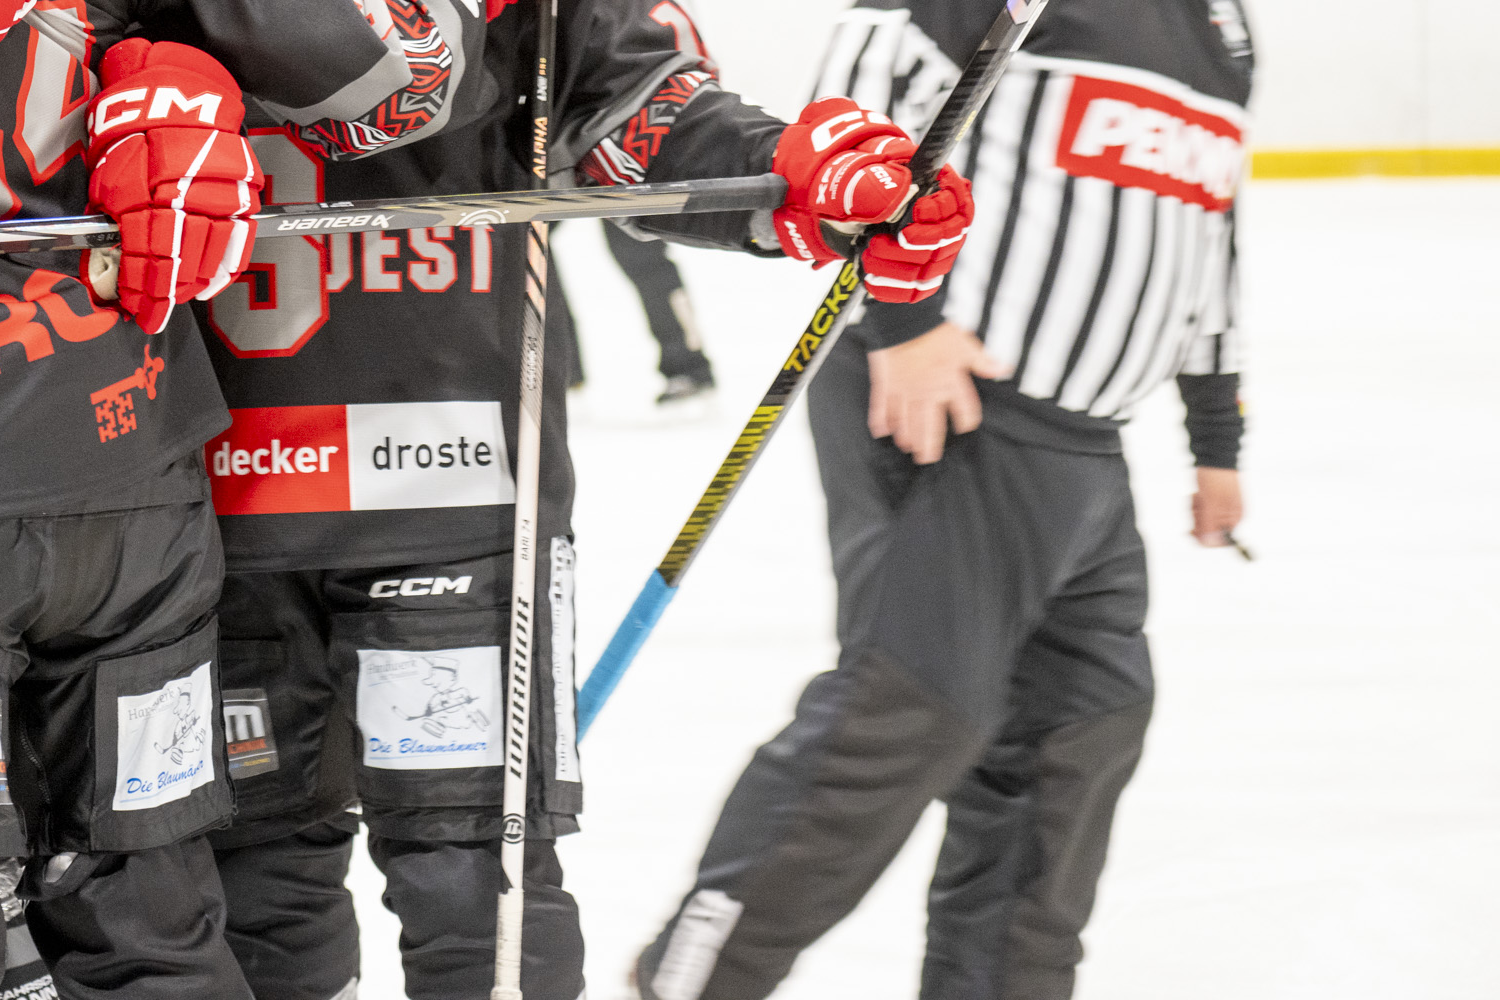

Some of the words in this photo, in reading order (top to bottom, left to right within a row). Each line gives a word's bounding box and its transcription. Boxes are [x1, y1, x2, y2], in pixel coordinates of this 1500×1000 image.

[88, 86, 223, 135] CM
[532, 116, 548, 179] ALPHA
[869, 165, 898, 190] CCM
[783, 261, 861, 374] TACKS
[212, 439, 339, 477] decker
[371, 436, 493, 471] droste
[368, 575, 473, 599] CCM
[509, 596, 530, 779] WARRIOR
[369, 737, 393, 754] Die
[398, 736, 488, 754] Blaumänner
[126, 776, 153, 795] Die
